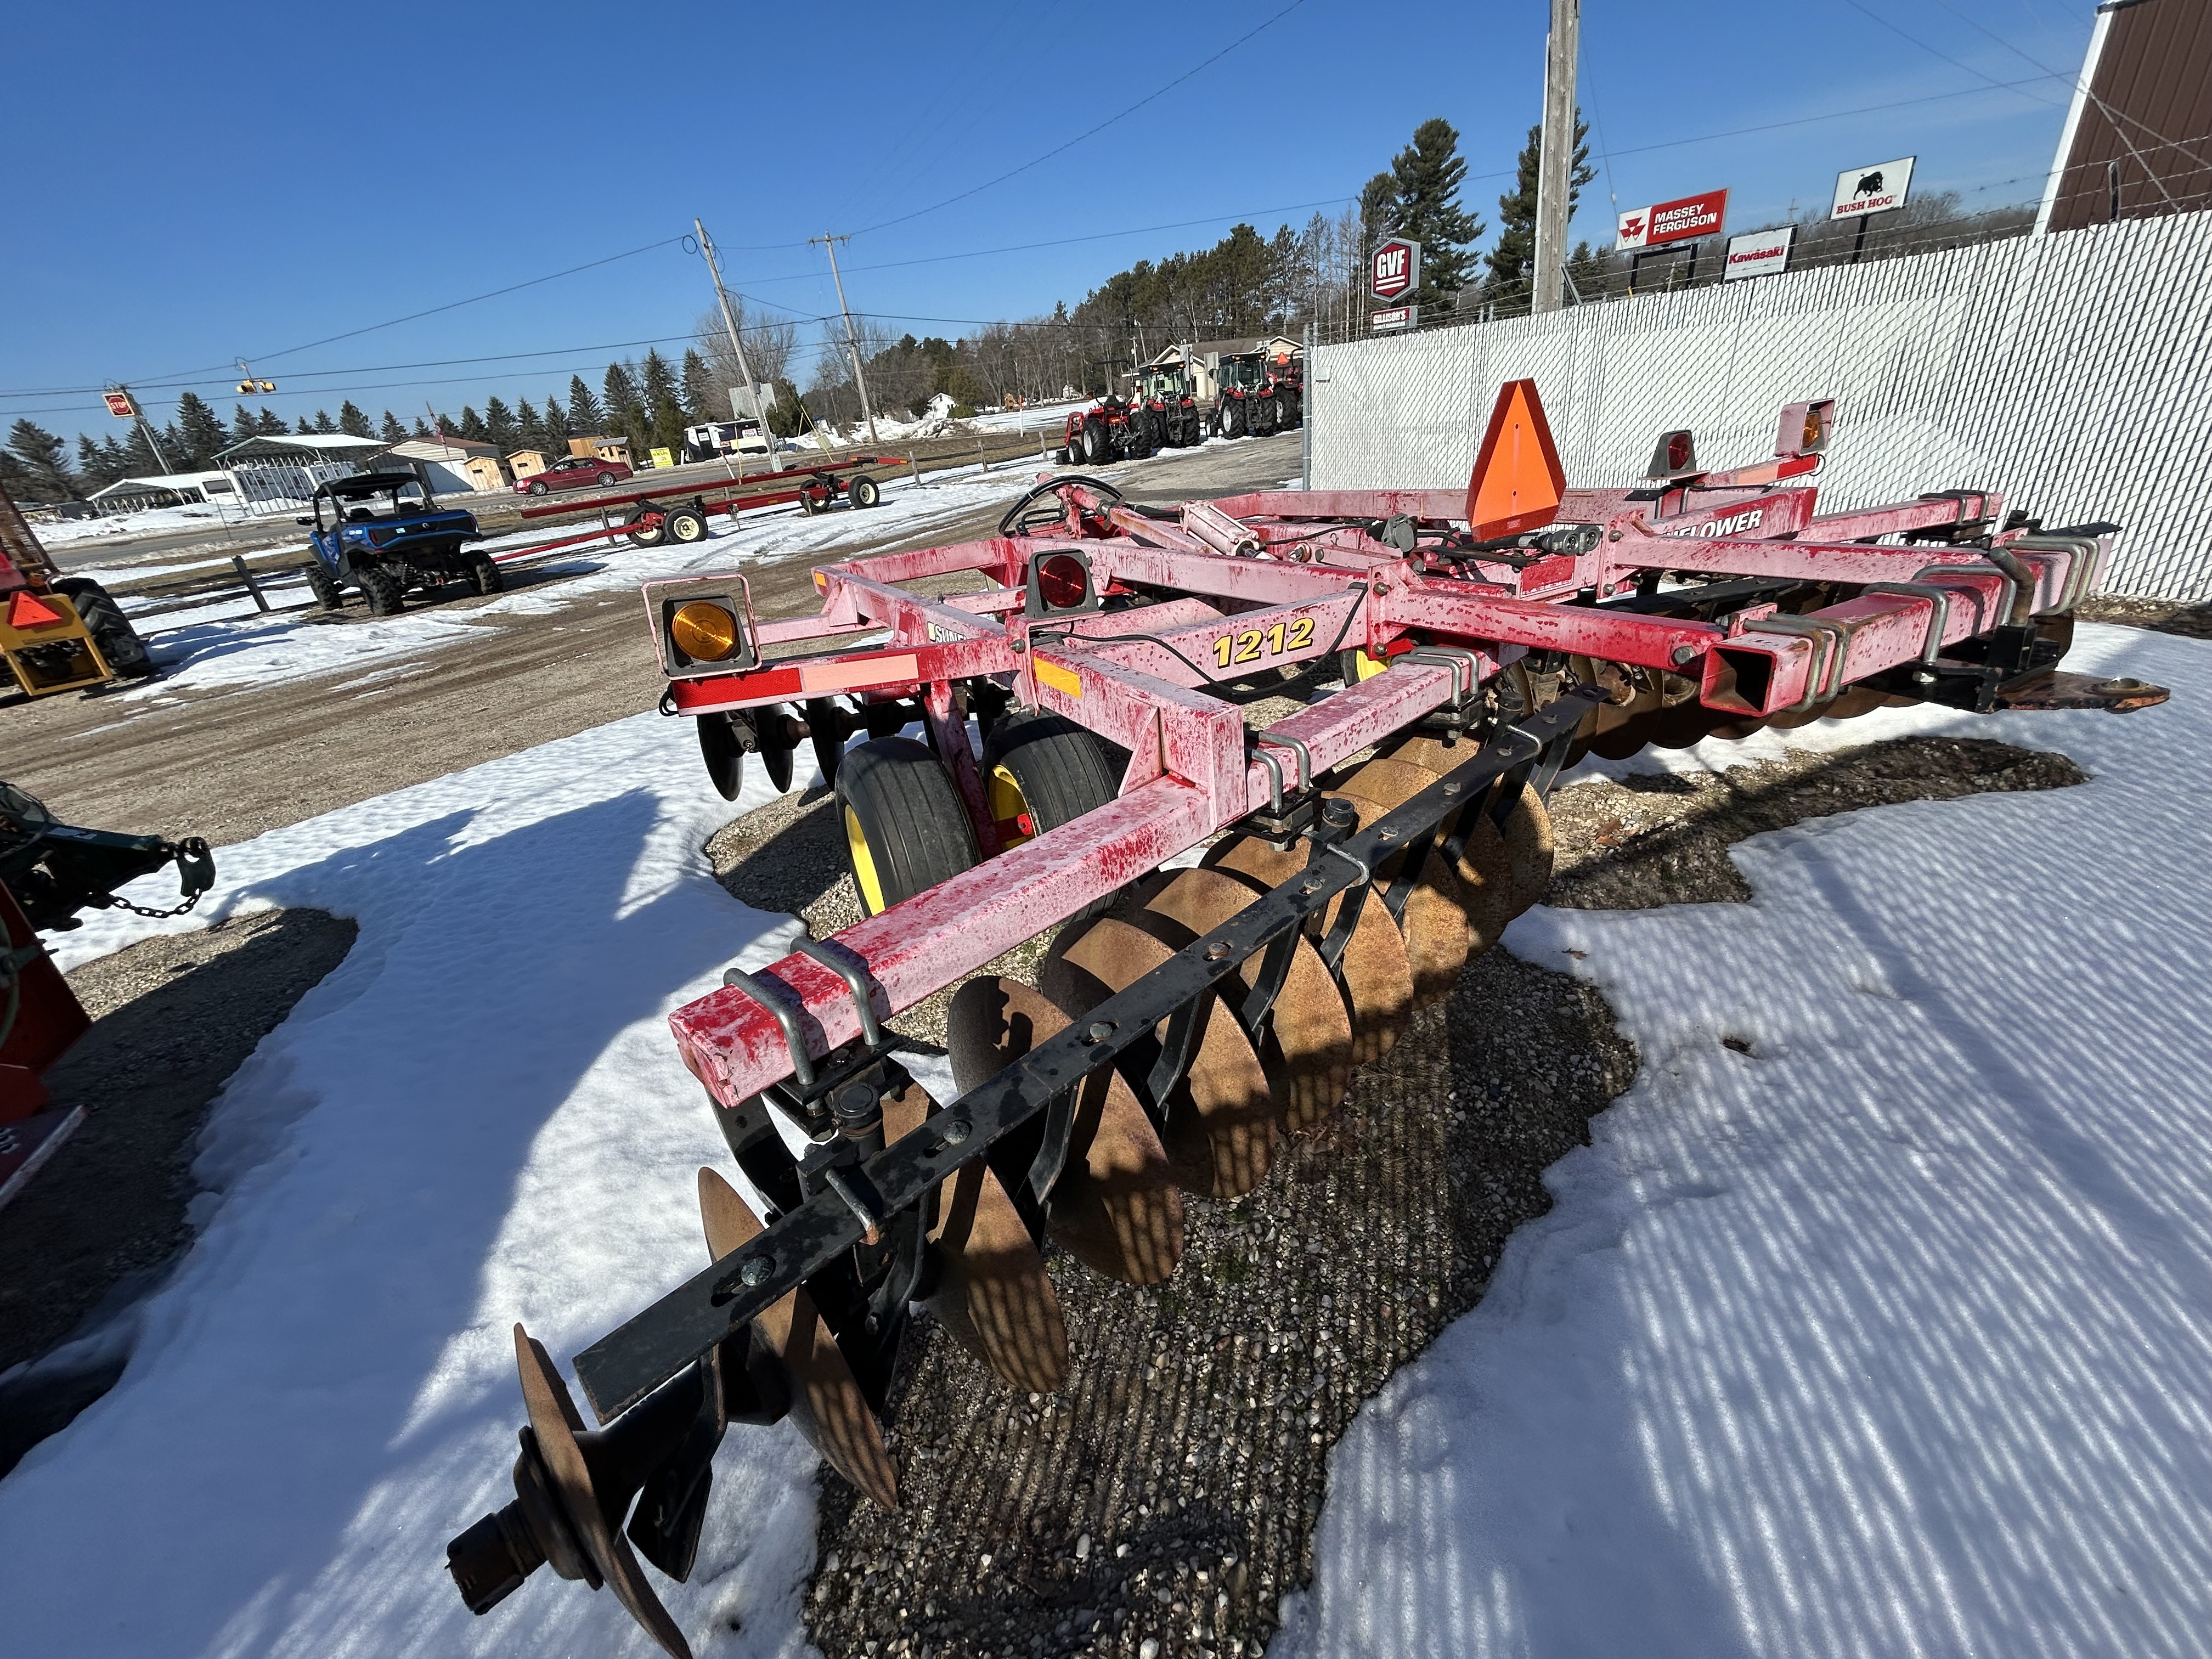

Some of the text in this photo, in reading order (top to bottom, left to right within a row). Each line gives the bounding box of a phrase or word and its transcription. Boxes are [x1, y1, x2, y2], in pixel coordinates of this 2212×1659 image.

[1654, 203, 1705, 224] MASSEY
[1836, 195, 1893, 214] BUSH HOG
[1652, 212, 1717, 235] FERGUSON
[1376, 249, 1406, 279] GVF
[1729, 245, 1785, 264] Kawasaki
[110, 401, 127, 409] STOP
[1213, 617, 1315, 669] 1212
